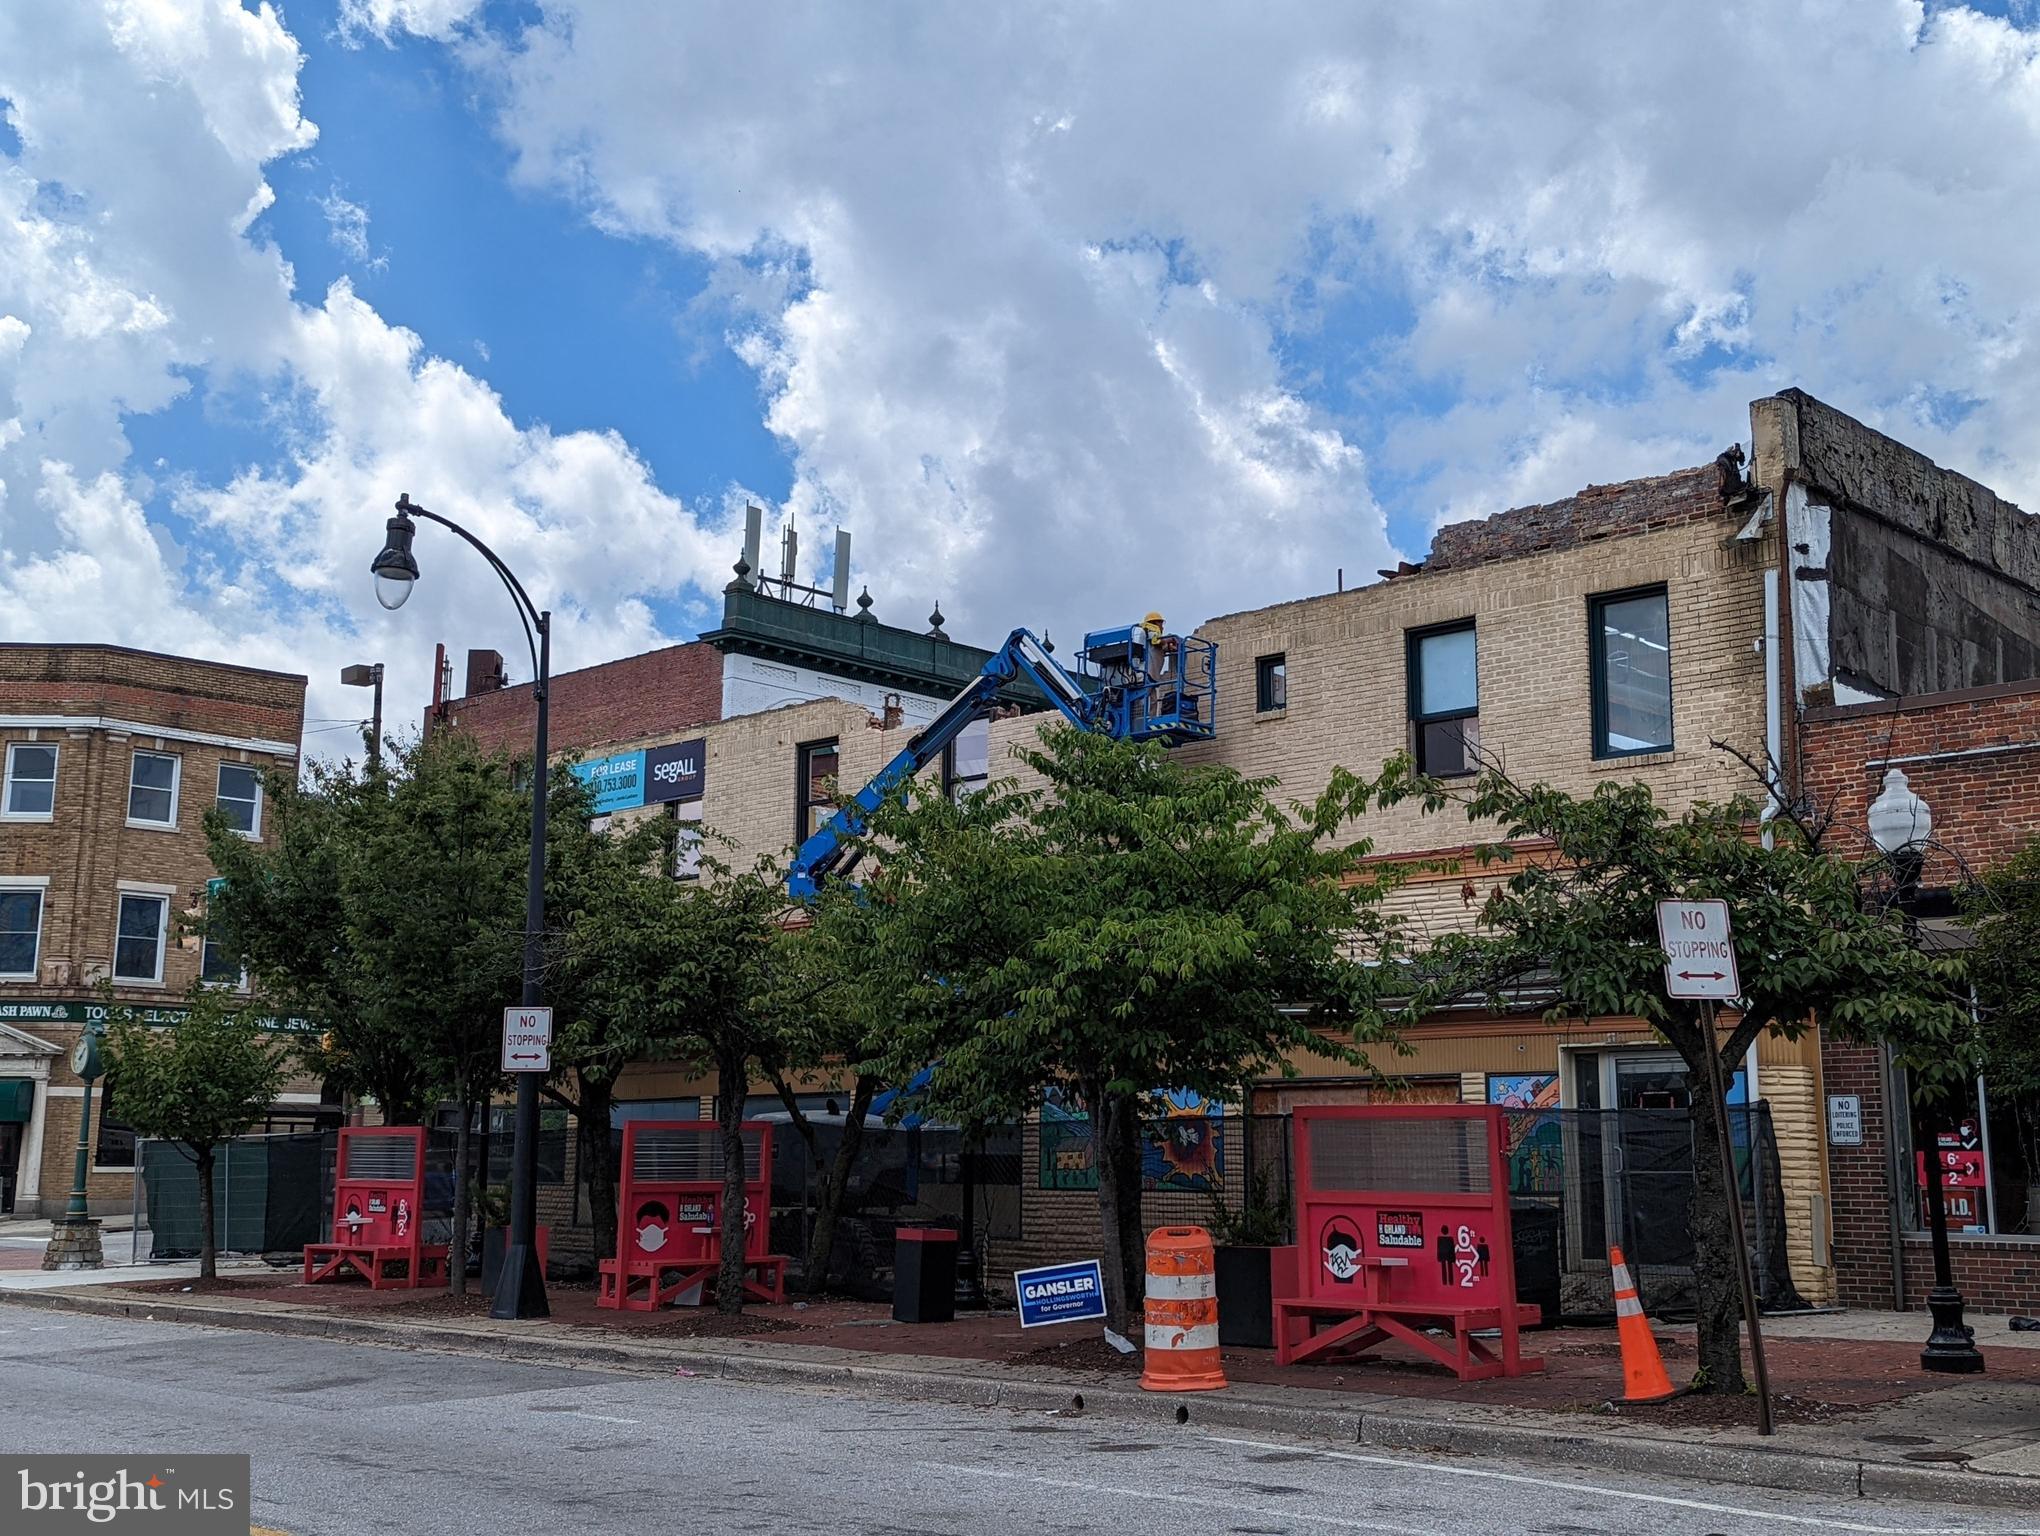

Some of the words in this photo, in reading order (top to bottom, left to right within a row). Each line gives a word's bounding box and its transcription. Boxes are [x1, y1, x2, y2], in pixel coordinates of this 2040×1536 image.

[591, 765, 609, 778] FOR
[610, 759, 637, 774] LEASE
[591, 774, 637, 793] 10.753.3000
[1681, 911, 1706, 930] NO
[1669, 941, 1728, 959] STOPPING
[0, 1006, 16, 1017] SH
[19, 1006, 51, 1017] PAWN
[84, 1006, 133, 1020] TOS
[520, 1015, 536, 1028] NO
[507, 1034, 547, 1046] STOPPING
[1838, 1100, 1850, 1110] NO
[1832, 1111, 1857, 1119] LOITERING
[1833, 1130, 1859, 1138] ENFORCED
[1951, 1198, 1972, 1216] I.D.
[680, 1211, 709, 1221] Saludab
[1379, 1214, 1421, 1224] Healthy
[1379, 1233, 1422, 1246] Saludable
[1025, 1277, 1094, 1299] GANSLER
[1036, 1291, 1094, 1305] HOLLINGSWORTH
[1052, 1301, 1084, 1311] Governor
